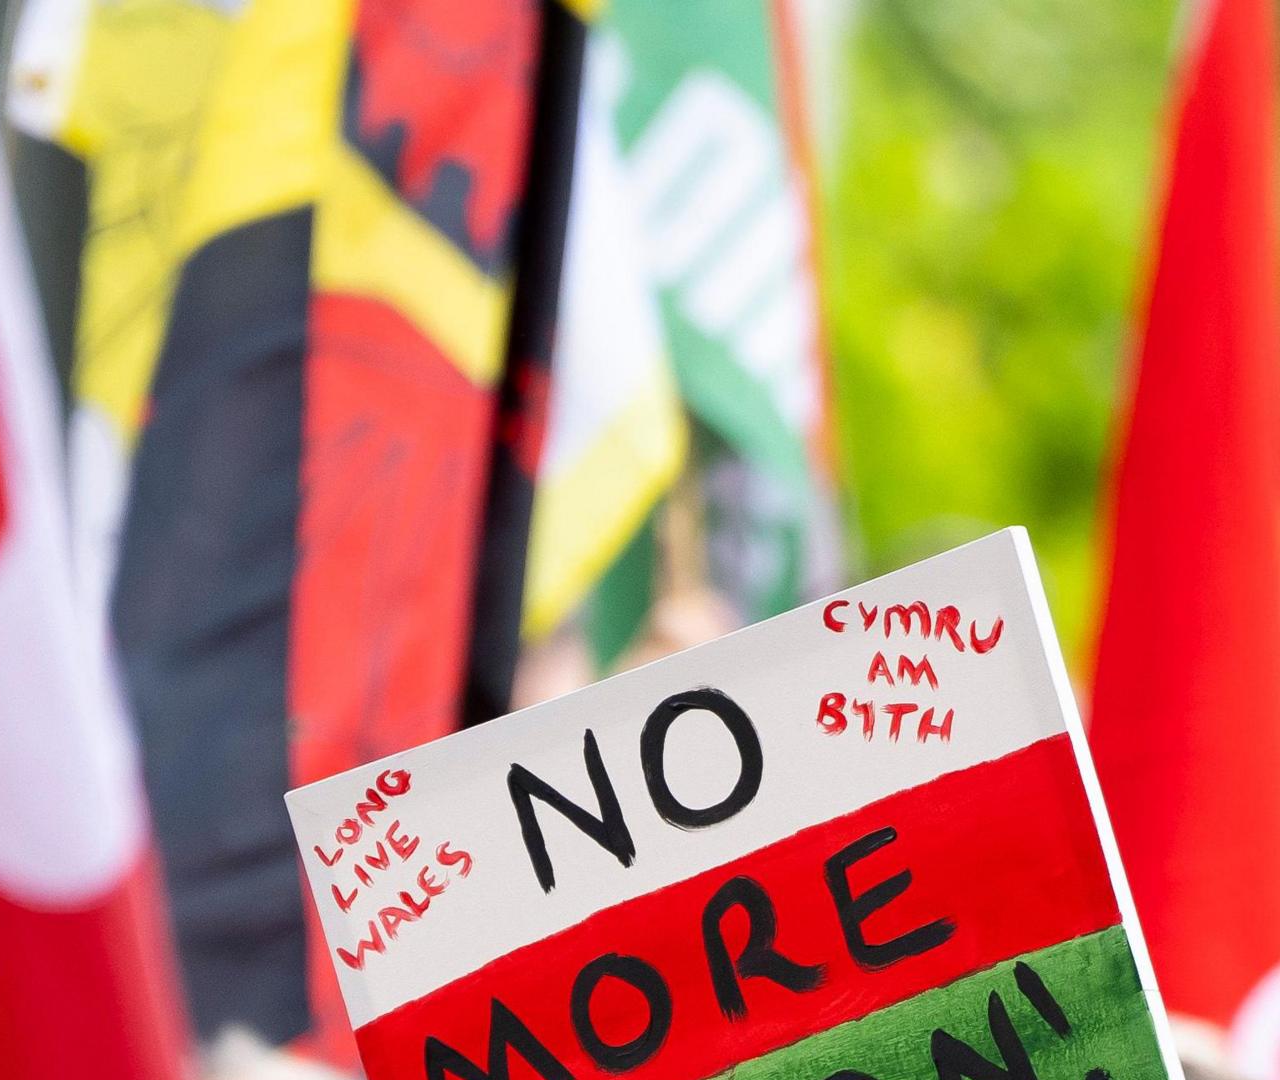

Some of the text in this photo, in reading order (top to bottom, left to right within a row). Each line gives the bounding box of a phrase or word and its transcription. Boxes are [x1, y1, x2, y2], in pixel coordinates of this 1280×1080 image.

[823, 600, 1005, 654] CYMRU
[867, 651, 939, 690] AM
[816, 692, 955, 743] BYTH
[313, 769, 413, 867] LONG
[507, 685, 764, 895] NO
[331, 819, 420, 914] LIVE
[336, 840, 475, 971] WALES
